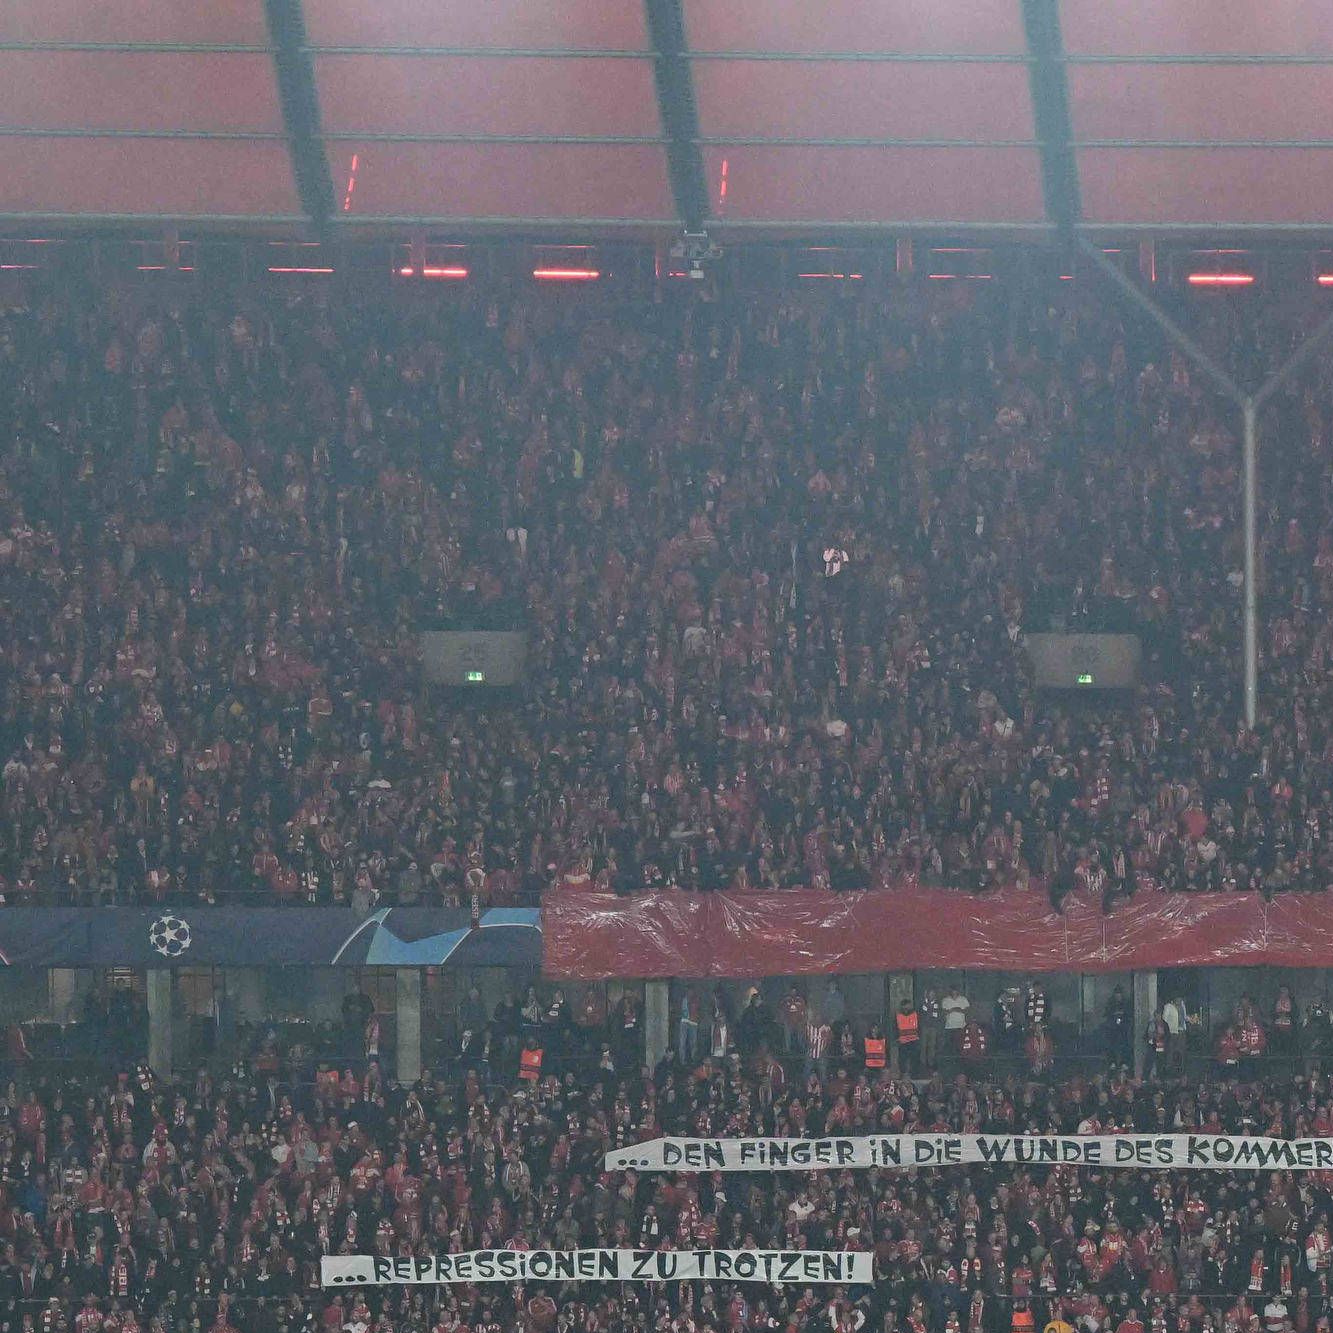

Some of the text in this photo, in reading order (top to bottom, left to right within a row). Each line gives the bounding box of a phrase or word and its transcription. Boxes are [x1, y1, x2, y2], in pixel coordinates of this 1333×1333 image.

[663, 1141, 726, 1168] DEN
[976, 1137, 1101, 1162] WUNDE
[1115, 1139, 1174, 1164] DES
[631, 1252, 678, 1279] ZU
[692, 1251, 855, 1280] TROTZEN!
